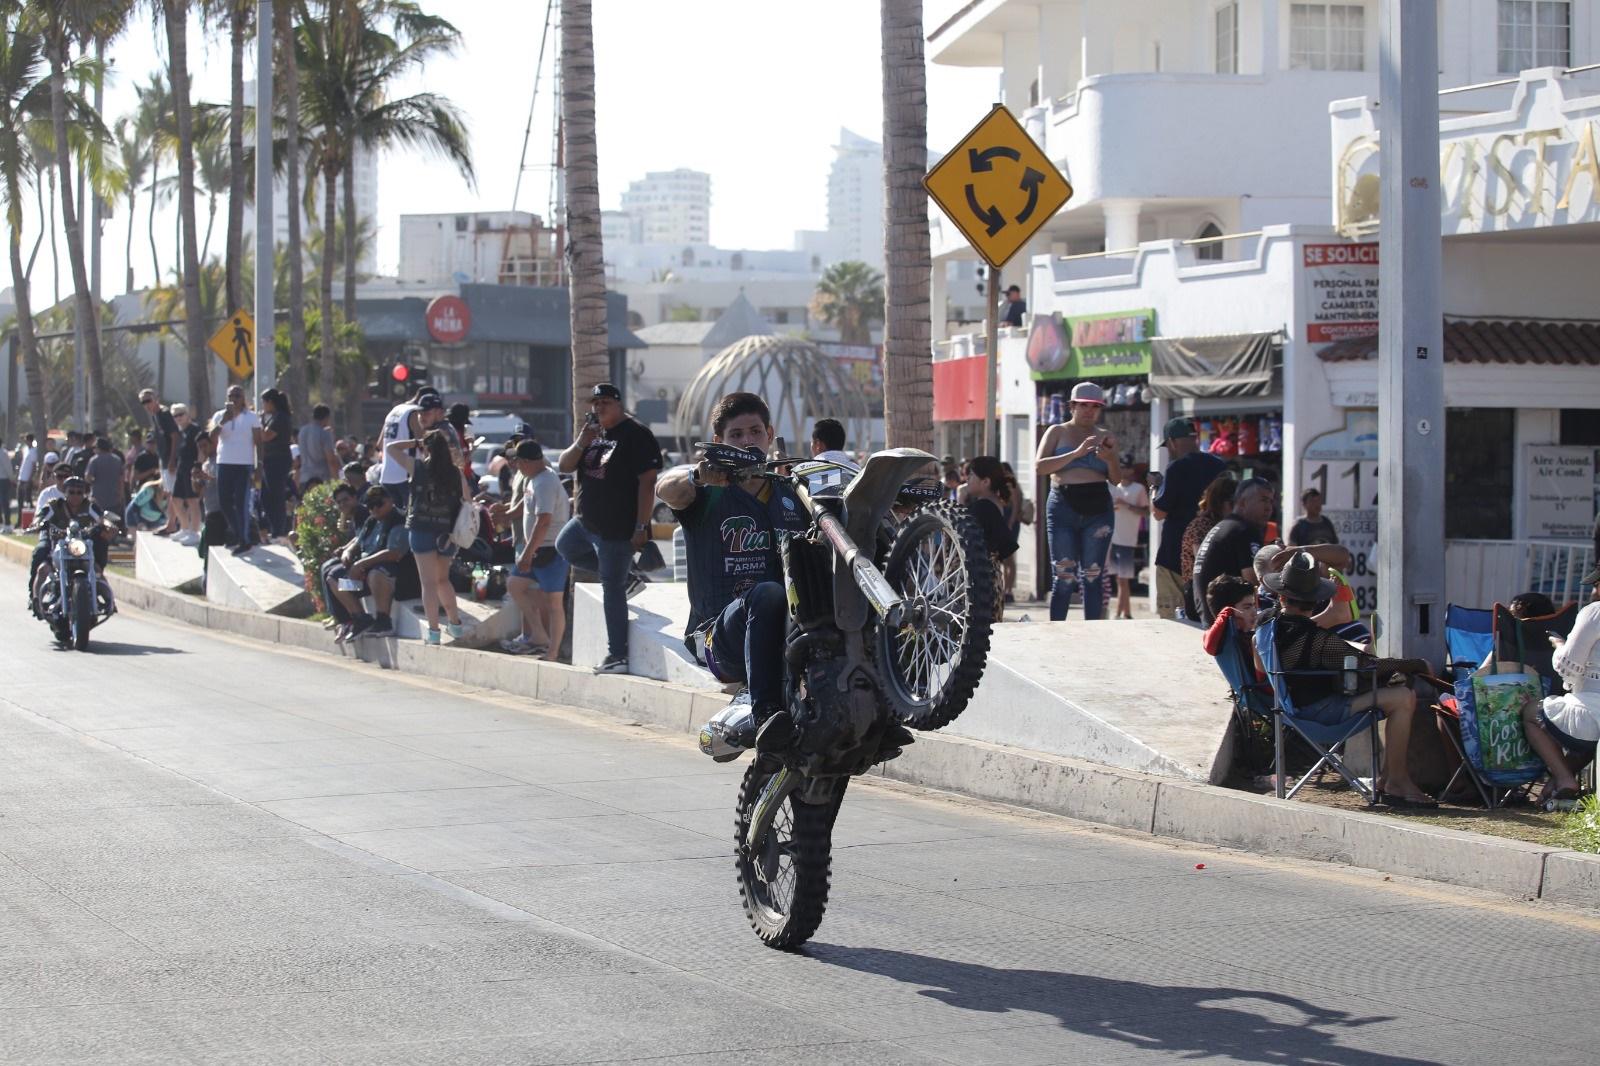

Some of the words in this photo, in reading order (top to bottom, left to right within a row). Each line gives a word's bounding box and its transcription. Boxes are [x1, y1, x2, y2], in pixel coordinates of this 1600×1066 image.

[1306, 247, 1323, 263] SE
[1314, 280, 1361, 288] PERSONAL
[1327, 290, 1336, 299] EL
[1366, 290, 1378, 298] DE
[1321, 301, 1375, 310] CAMARISTA
